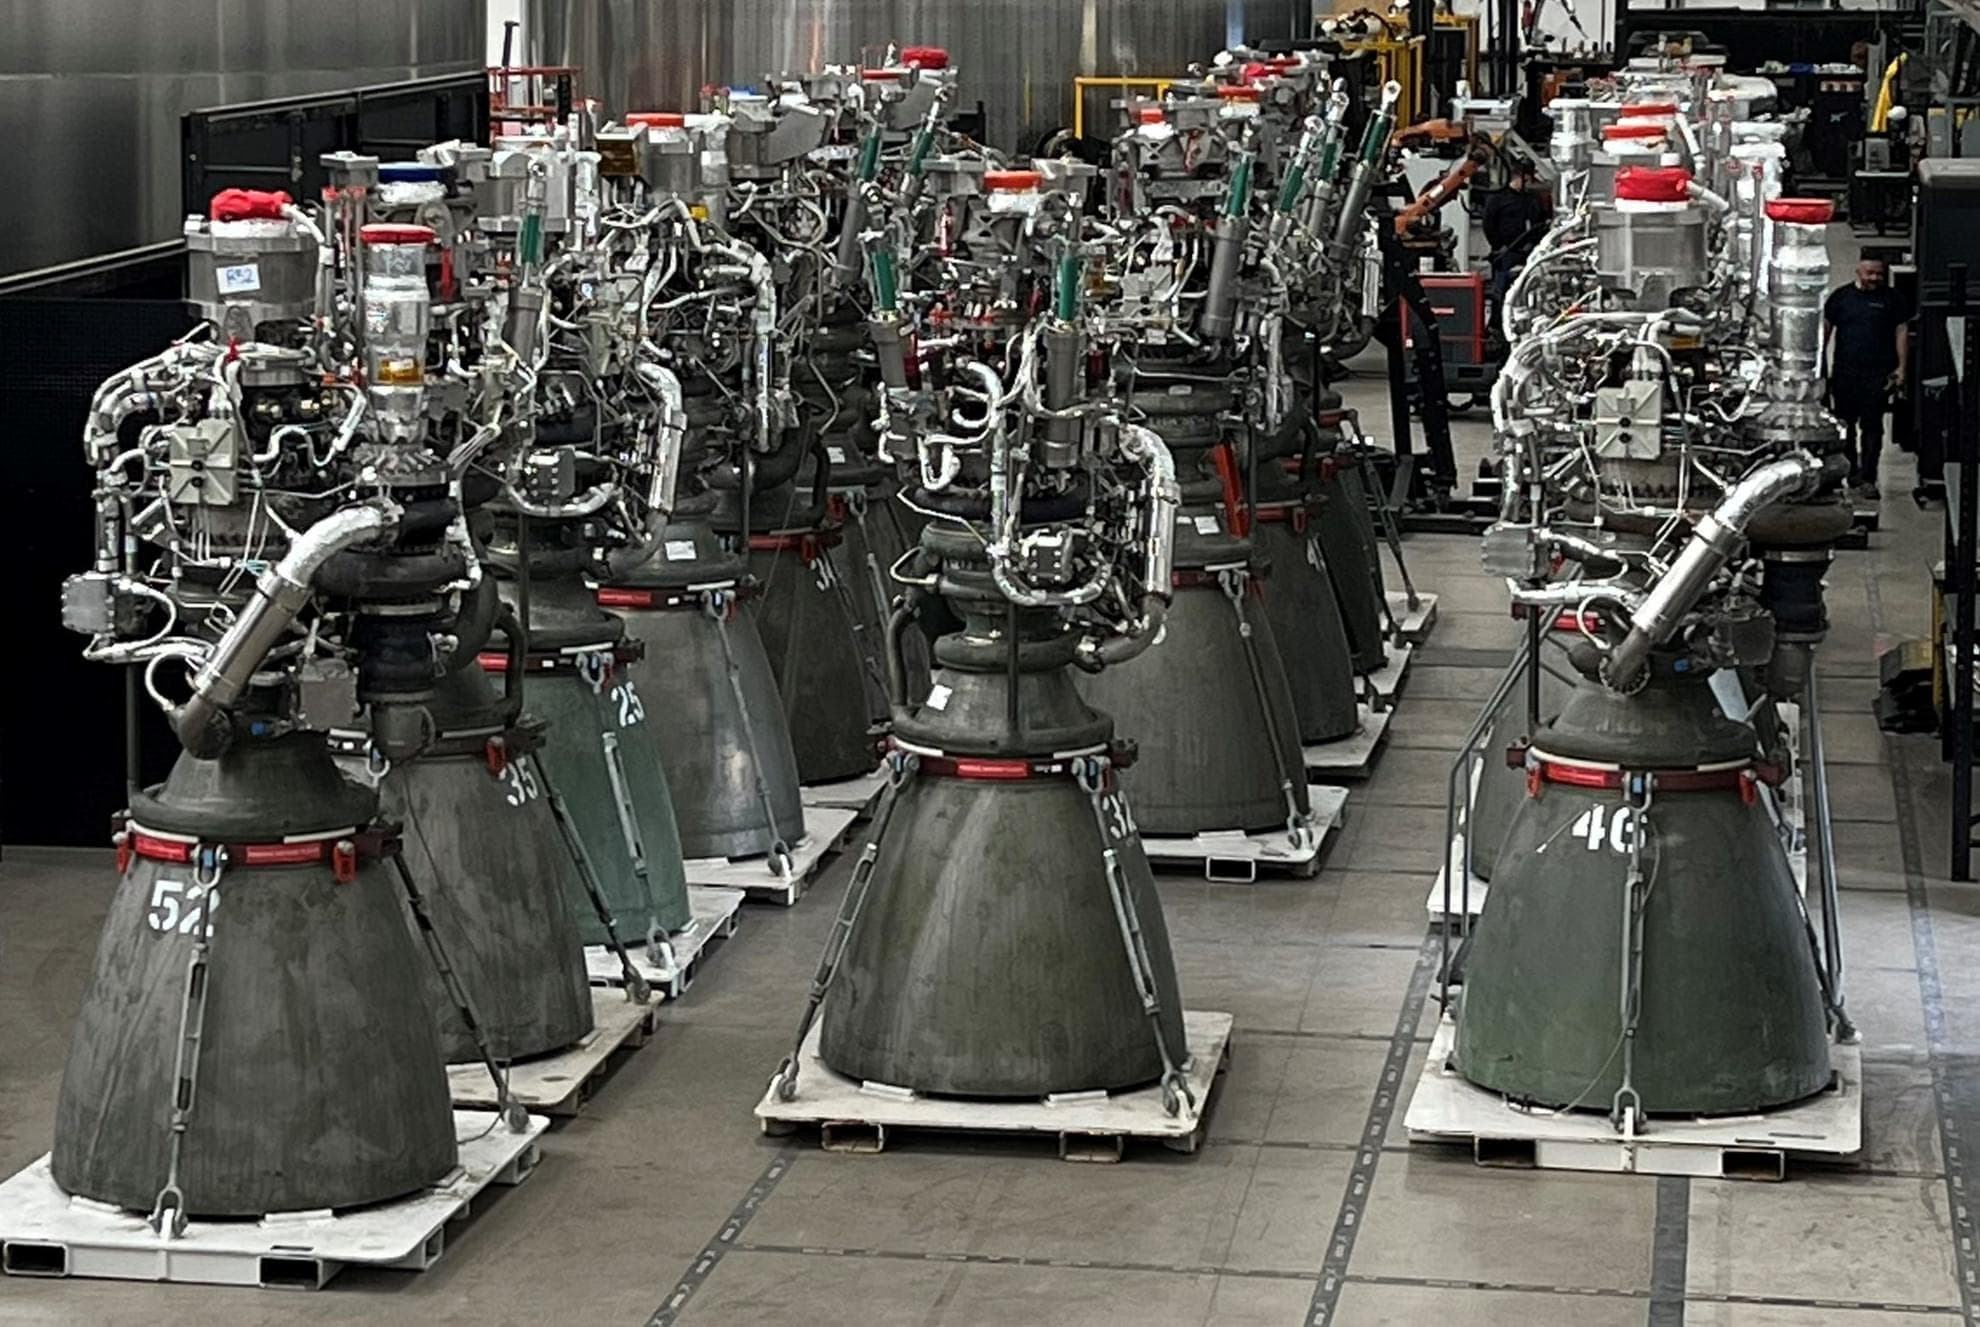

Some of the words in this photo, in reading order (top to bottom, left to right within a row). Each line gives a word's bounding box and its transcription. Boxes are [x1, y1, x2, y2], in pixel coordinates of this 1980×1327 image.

[610, 681, 645, 727] 25
[498, 757, 538, 806] 35
[1571, 803, 1648, 853] 46
[148, 880, 221, 937] 52
